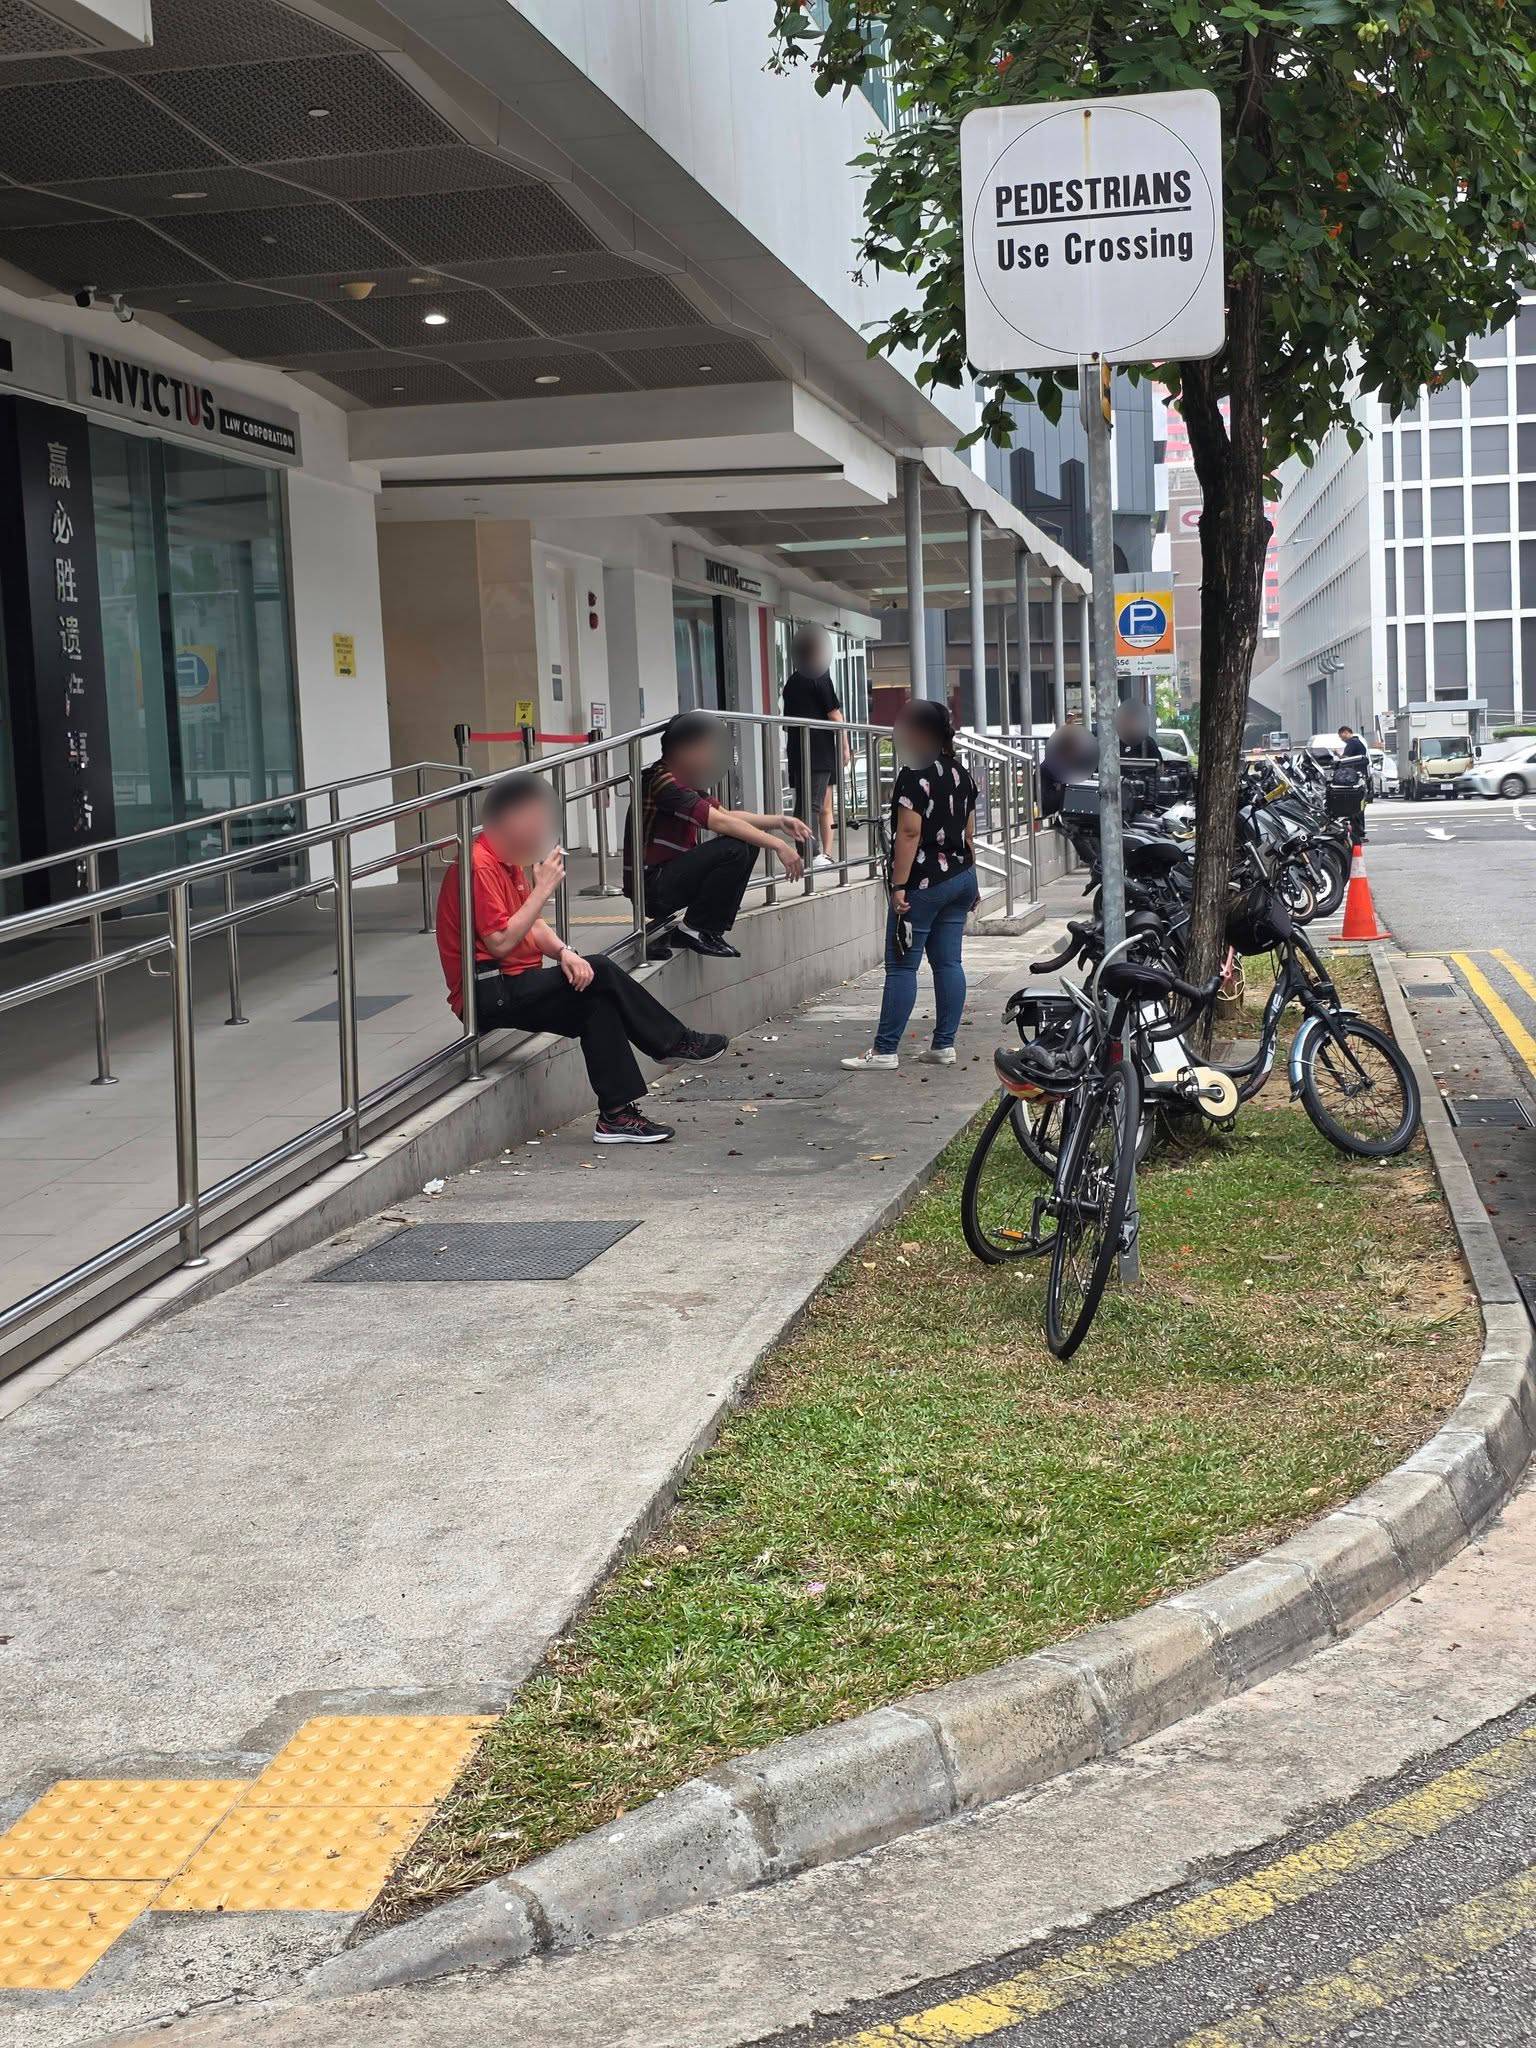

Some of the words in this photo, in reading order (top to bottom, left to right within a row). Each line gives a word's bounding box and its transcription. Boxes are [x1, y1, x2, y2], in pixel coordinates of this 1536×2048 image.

[995, 169, 1192, 219] PEDESTRIANS
[997, 238, 1050, 271] Use
[1064, 227, 1193, 265] Crossing
[88, 351, 216, 431] INVICTUS
[224, 415, 241, 431] LAW
[242, 421, 294, 448] CORPORATION
[1129, 604, 1157, 635] P
